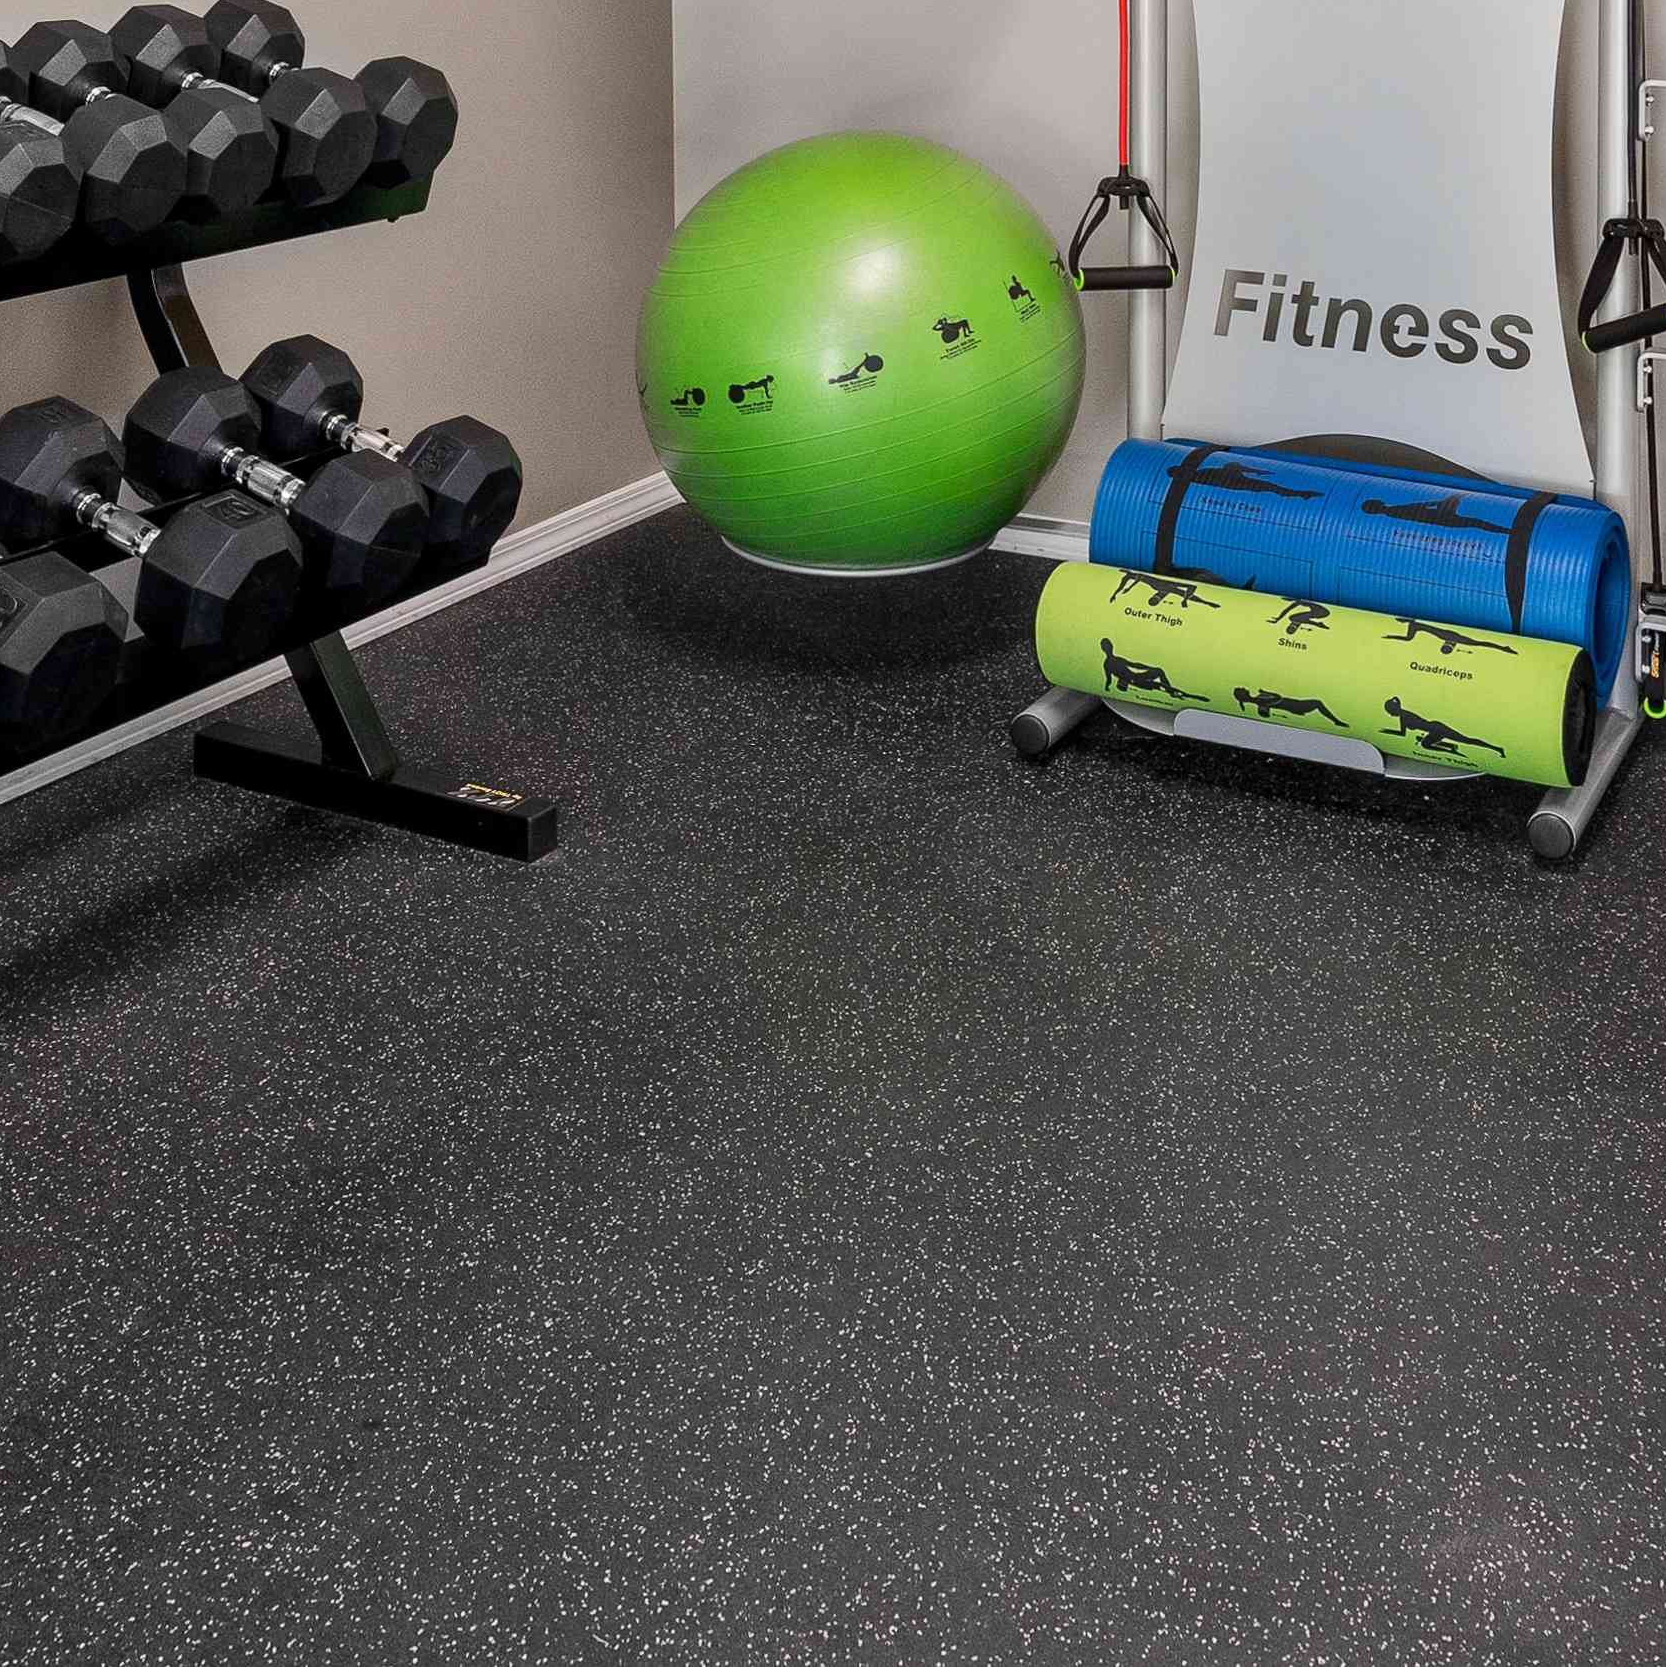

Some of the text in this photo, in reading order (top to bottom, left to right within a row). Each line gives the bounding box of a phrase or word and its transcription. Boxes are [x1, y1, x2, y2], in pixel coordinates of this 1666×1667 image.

[1213, 268, 1534, 370] Fitness
[1124, 606, 1184, 627] Outer Thigh
[1277, 637, 1308, 651] Shins
[1409, 661, 1474, 681] Quadriceps
